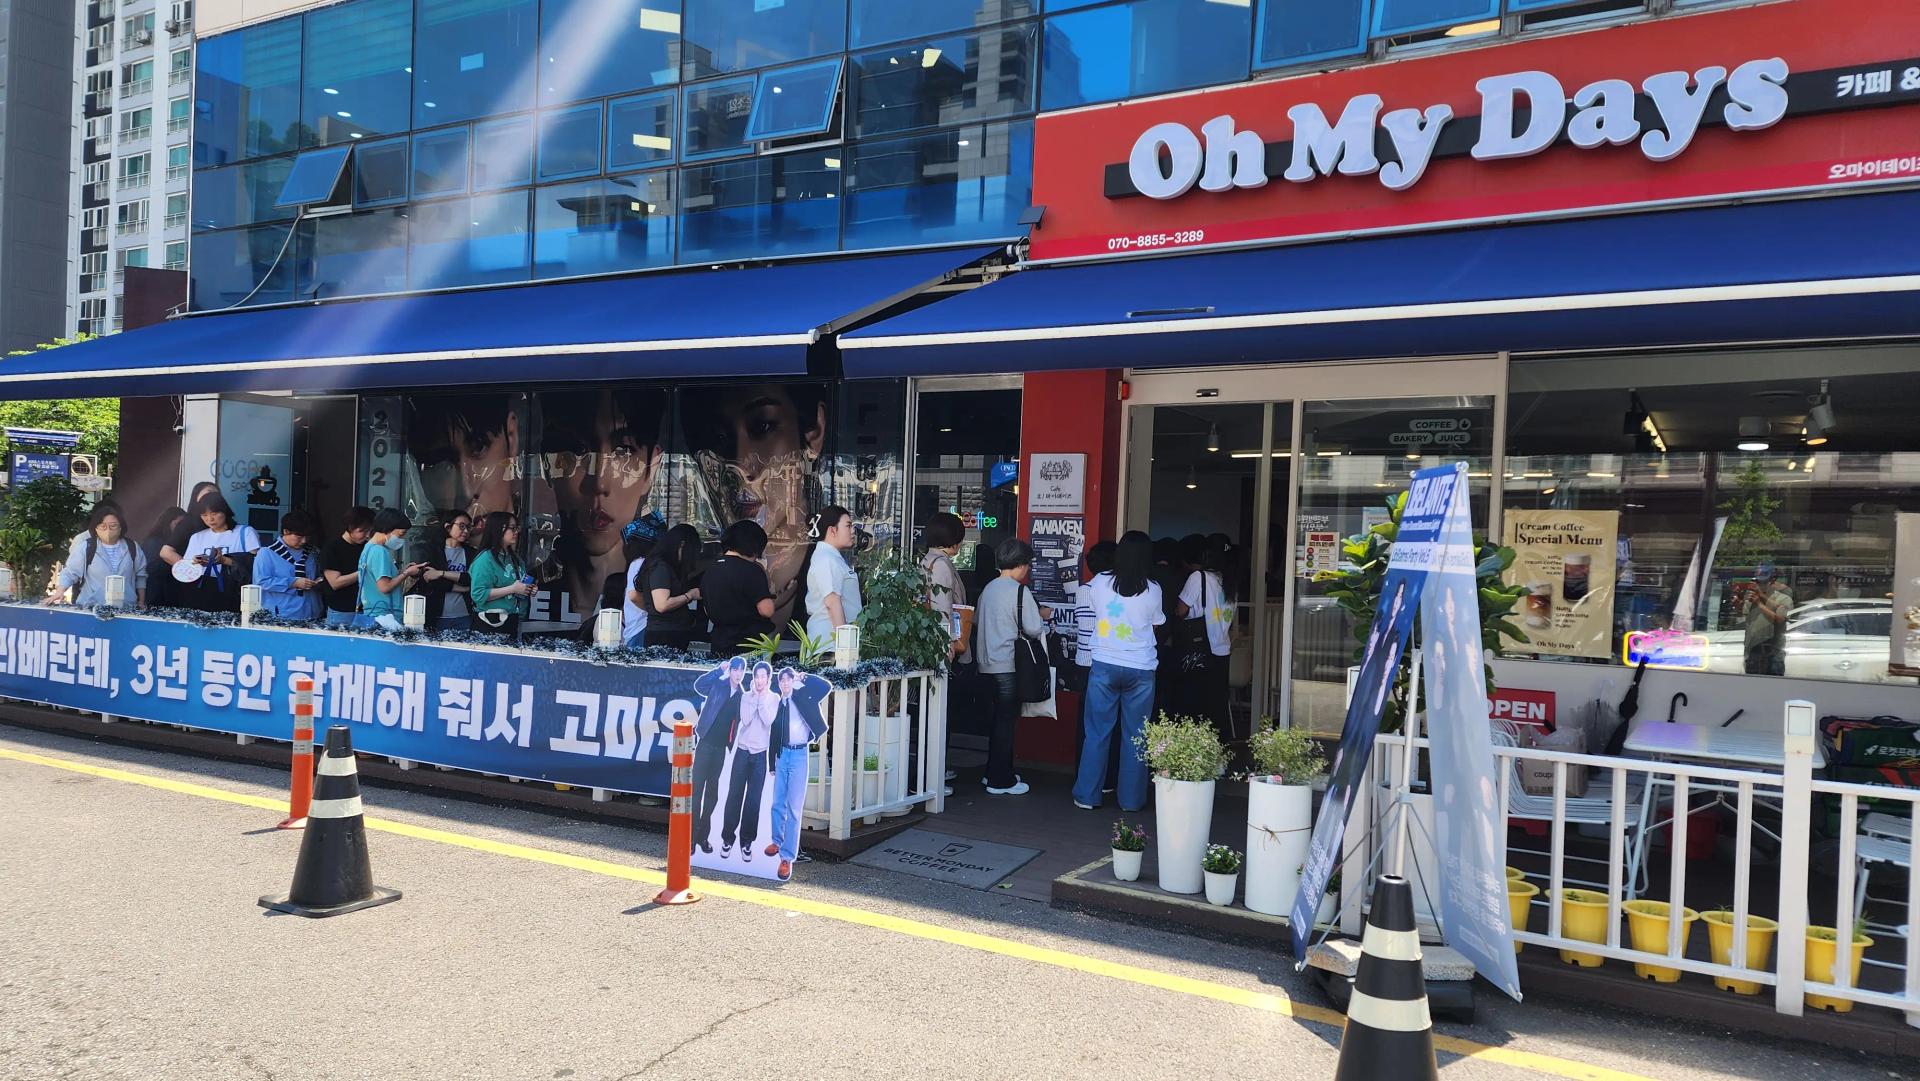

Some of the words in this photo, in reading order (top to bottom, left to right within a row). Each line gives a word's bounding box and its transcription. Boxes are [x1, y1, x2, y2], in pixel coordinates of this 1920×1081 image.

[1837, 69, 1892, 98] 카페
[1128, 114, 1269, 200] Oh
[1283, 93, 1454, 191] My
[1470, 56, 1790, 162] Days
[1107, 229, 1205, 251] 070-8855-3289
[1414, 420, 1453, 429] COFFEE
[1393, 434, 1429, 443] BAKERY
[1437, 434, 1466, 443] JUICE
[15, 454, 28, 468] P
[962, 511, 997, 530] Coffee
[1031, 519, 1083, 536] AWAKEN
[1520, 522, 1551, 531] Cream
[1553, 523, 1585, 532] Coffee
[1518, 533, 1563, 545] Special
[1566, 534, 1603, 546] Menu
[129, 644, 189, 701] 3년
[200, 650, 276, 712] 동안
[287, 655, 426, 732] 함께해
[437, 676, 534, 748] 줘서
[1879, 746, 1920, 757] 로켓프레
[883, 847, 936, 863] BETTER
[933, 858, 995, 874] MONDAY
[898, 857, 961, 874] COFFEE
